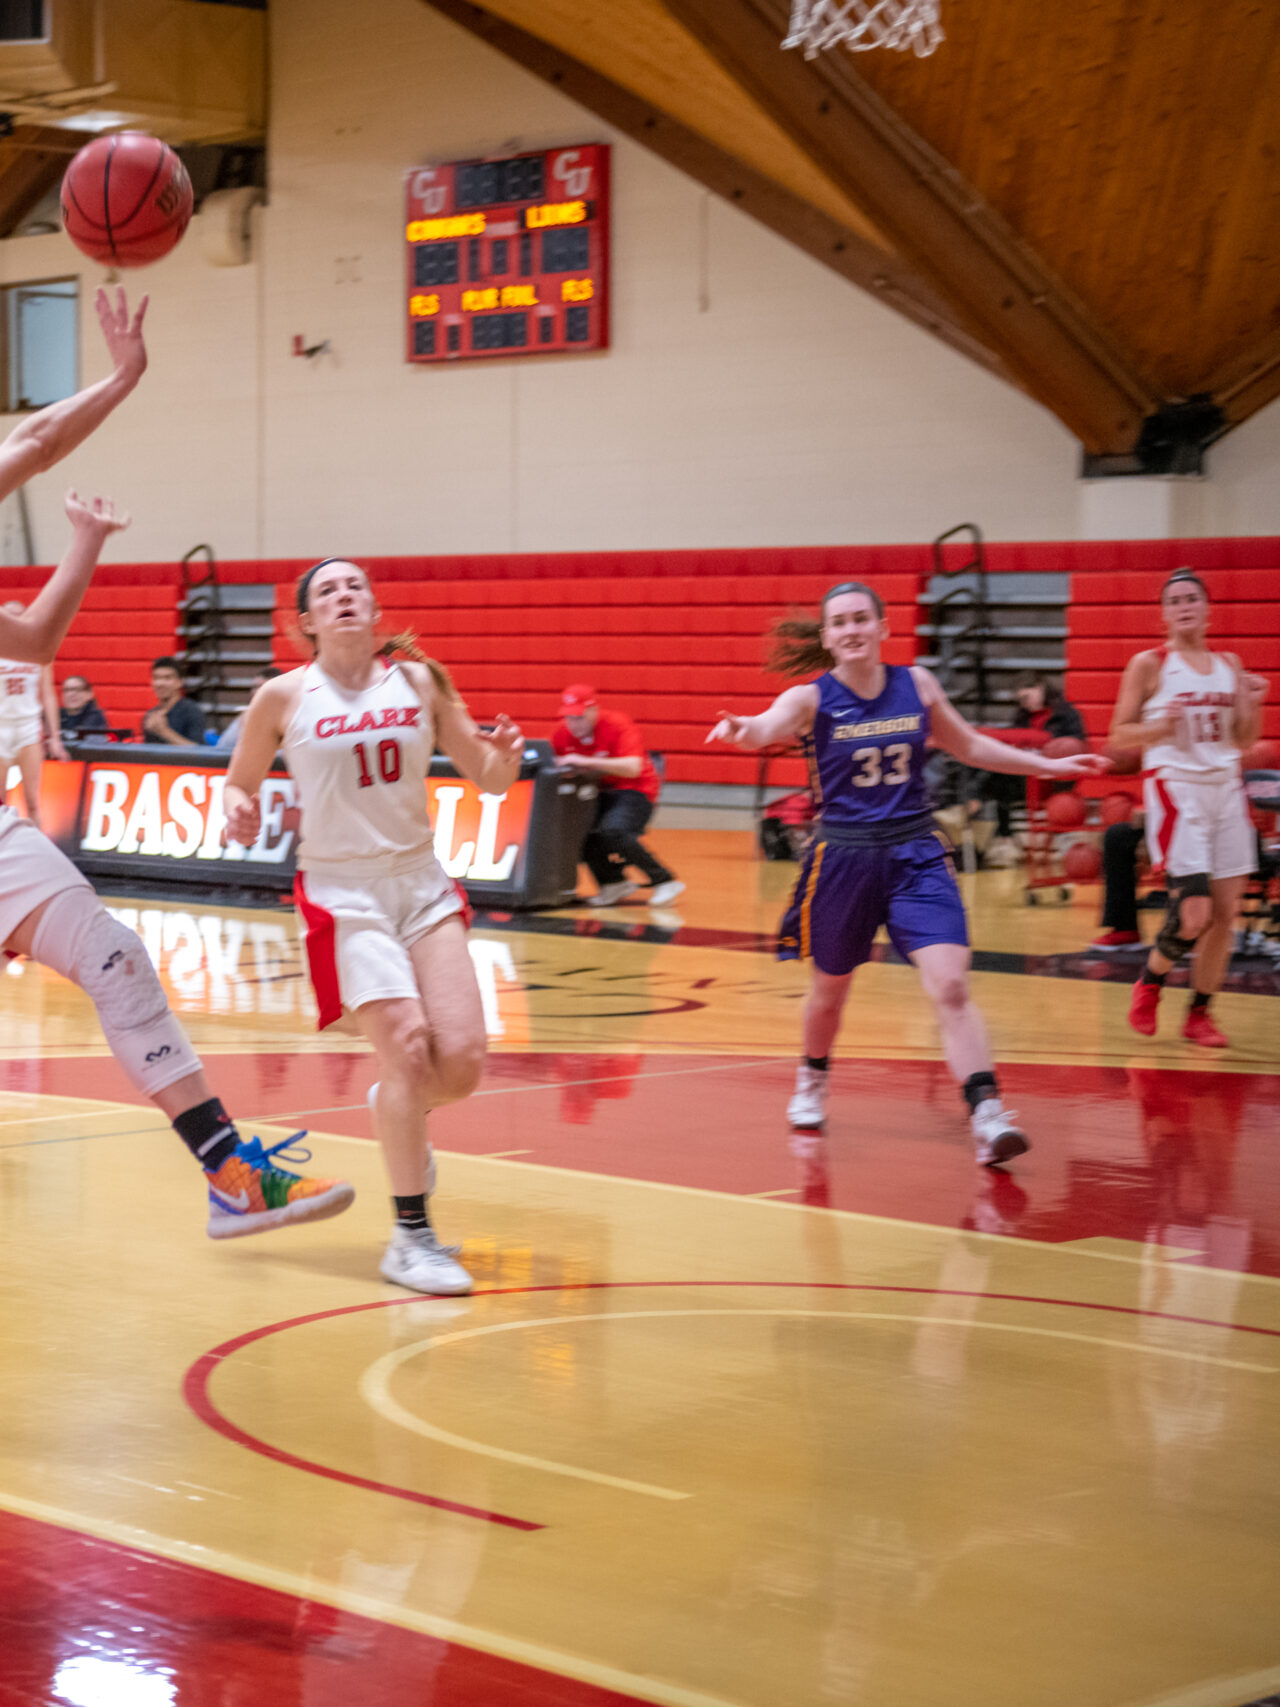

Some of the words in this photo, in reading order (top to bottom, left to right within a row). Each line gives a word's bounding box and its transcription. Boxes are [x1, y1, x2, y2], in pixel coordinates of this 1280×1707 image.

[315, 705, 422, 739] CLARK
[833, 715, 921, 740] EMERSON
[353, 739, 402, 788] 10
[851, 743, 913, 788] 33
